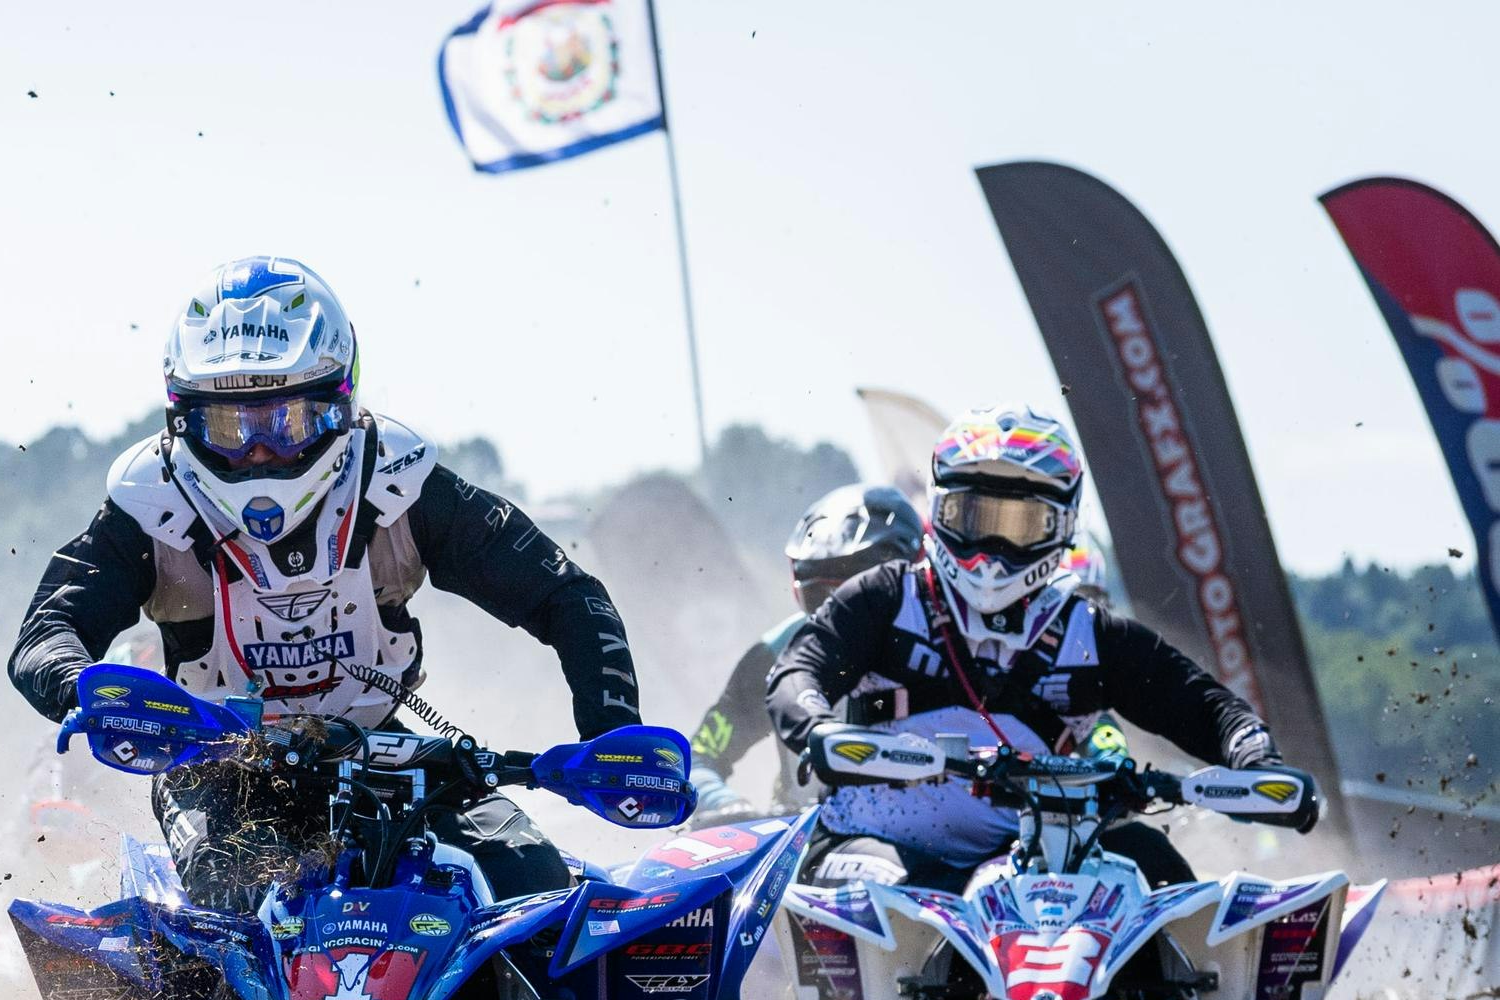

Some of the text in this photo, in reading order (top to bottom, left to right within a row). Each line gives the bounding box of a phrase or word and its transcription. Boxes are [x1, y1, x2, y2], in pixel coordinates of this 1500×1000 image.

[221, 323, 290, 342] YAMAHA
[250, 636, 349, 668] YAMAHA
[103, 715, 161, 736] FOWLER
[626, 774, 680, 793] FOWLER
[338, 919, 388, 934] YAMAHA
[1006, 931, 1102, 990] 3
